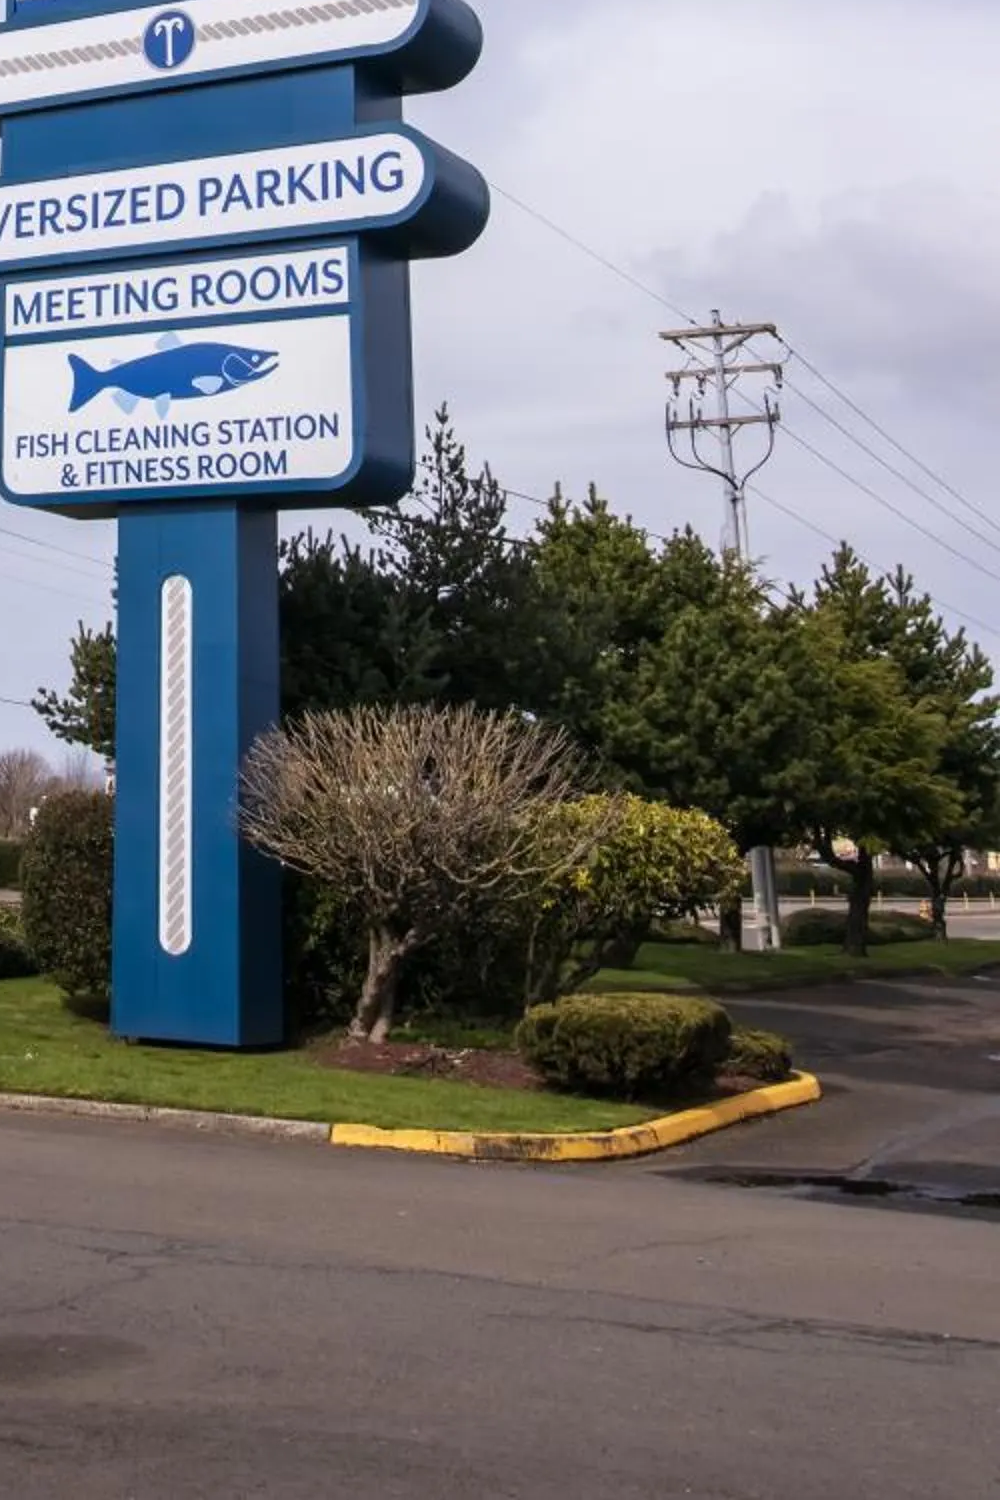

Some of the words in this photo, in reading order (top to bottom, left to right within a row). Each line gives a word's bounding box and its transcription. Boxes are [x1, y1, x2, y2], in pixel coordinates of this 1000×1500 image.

[199, 151, 404, 216] PARKING
[12, 276, 178, 325] MEETING
[191, 259, 343, 308] ROOMS
[16, 432, 69, 459] FISH
[75, 421, 209, 454] CLEANING
[218, 413, 339, 445] STATION
[61, 464, 80, 487] &
[86, 456, 190, 485] FITNESS
[198, 450, 287, 479] ROOM
